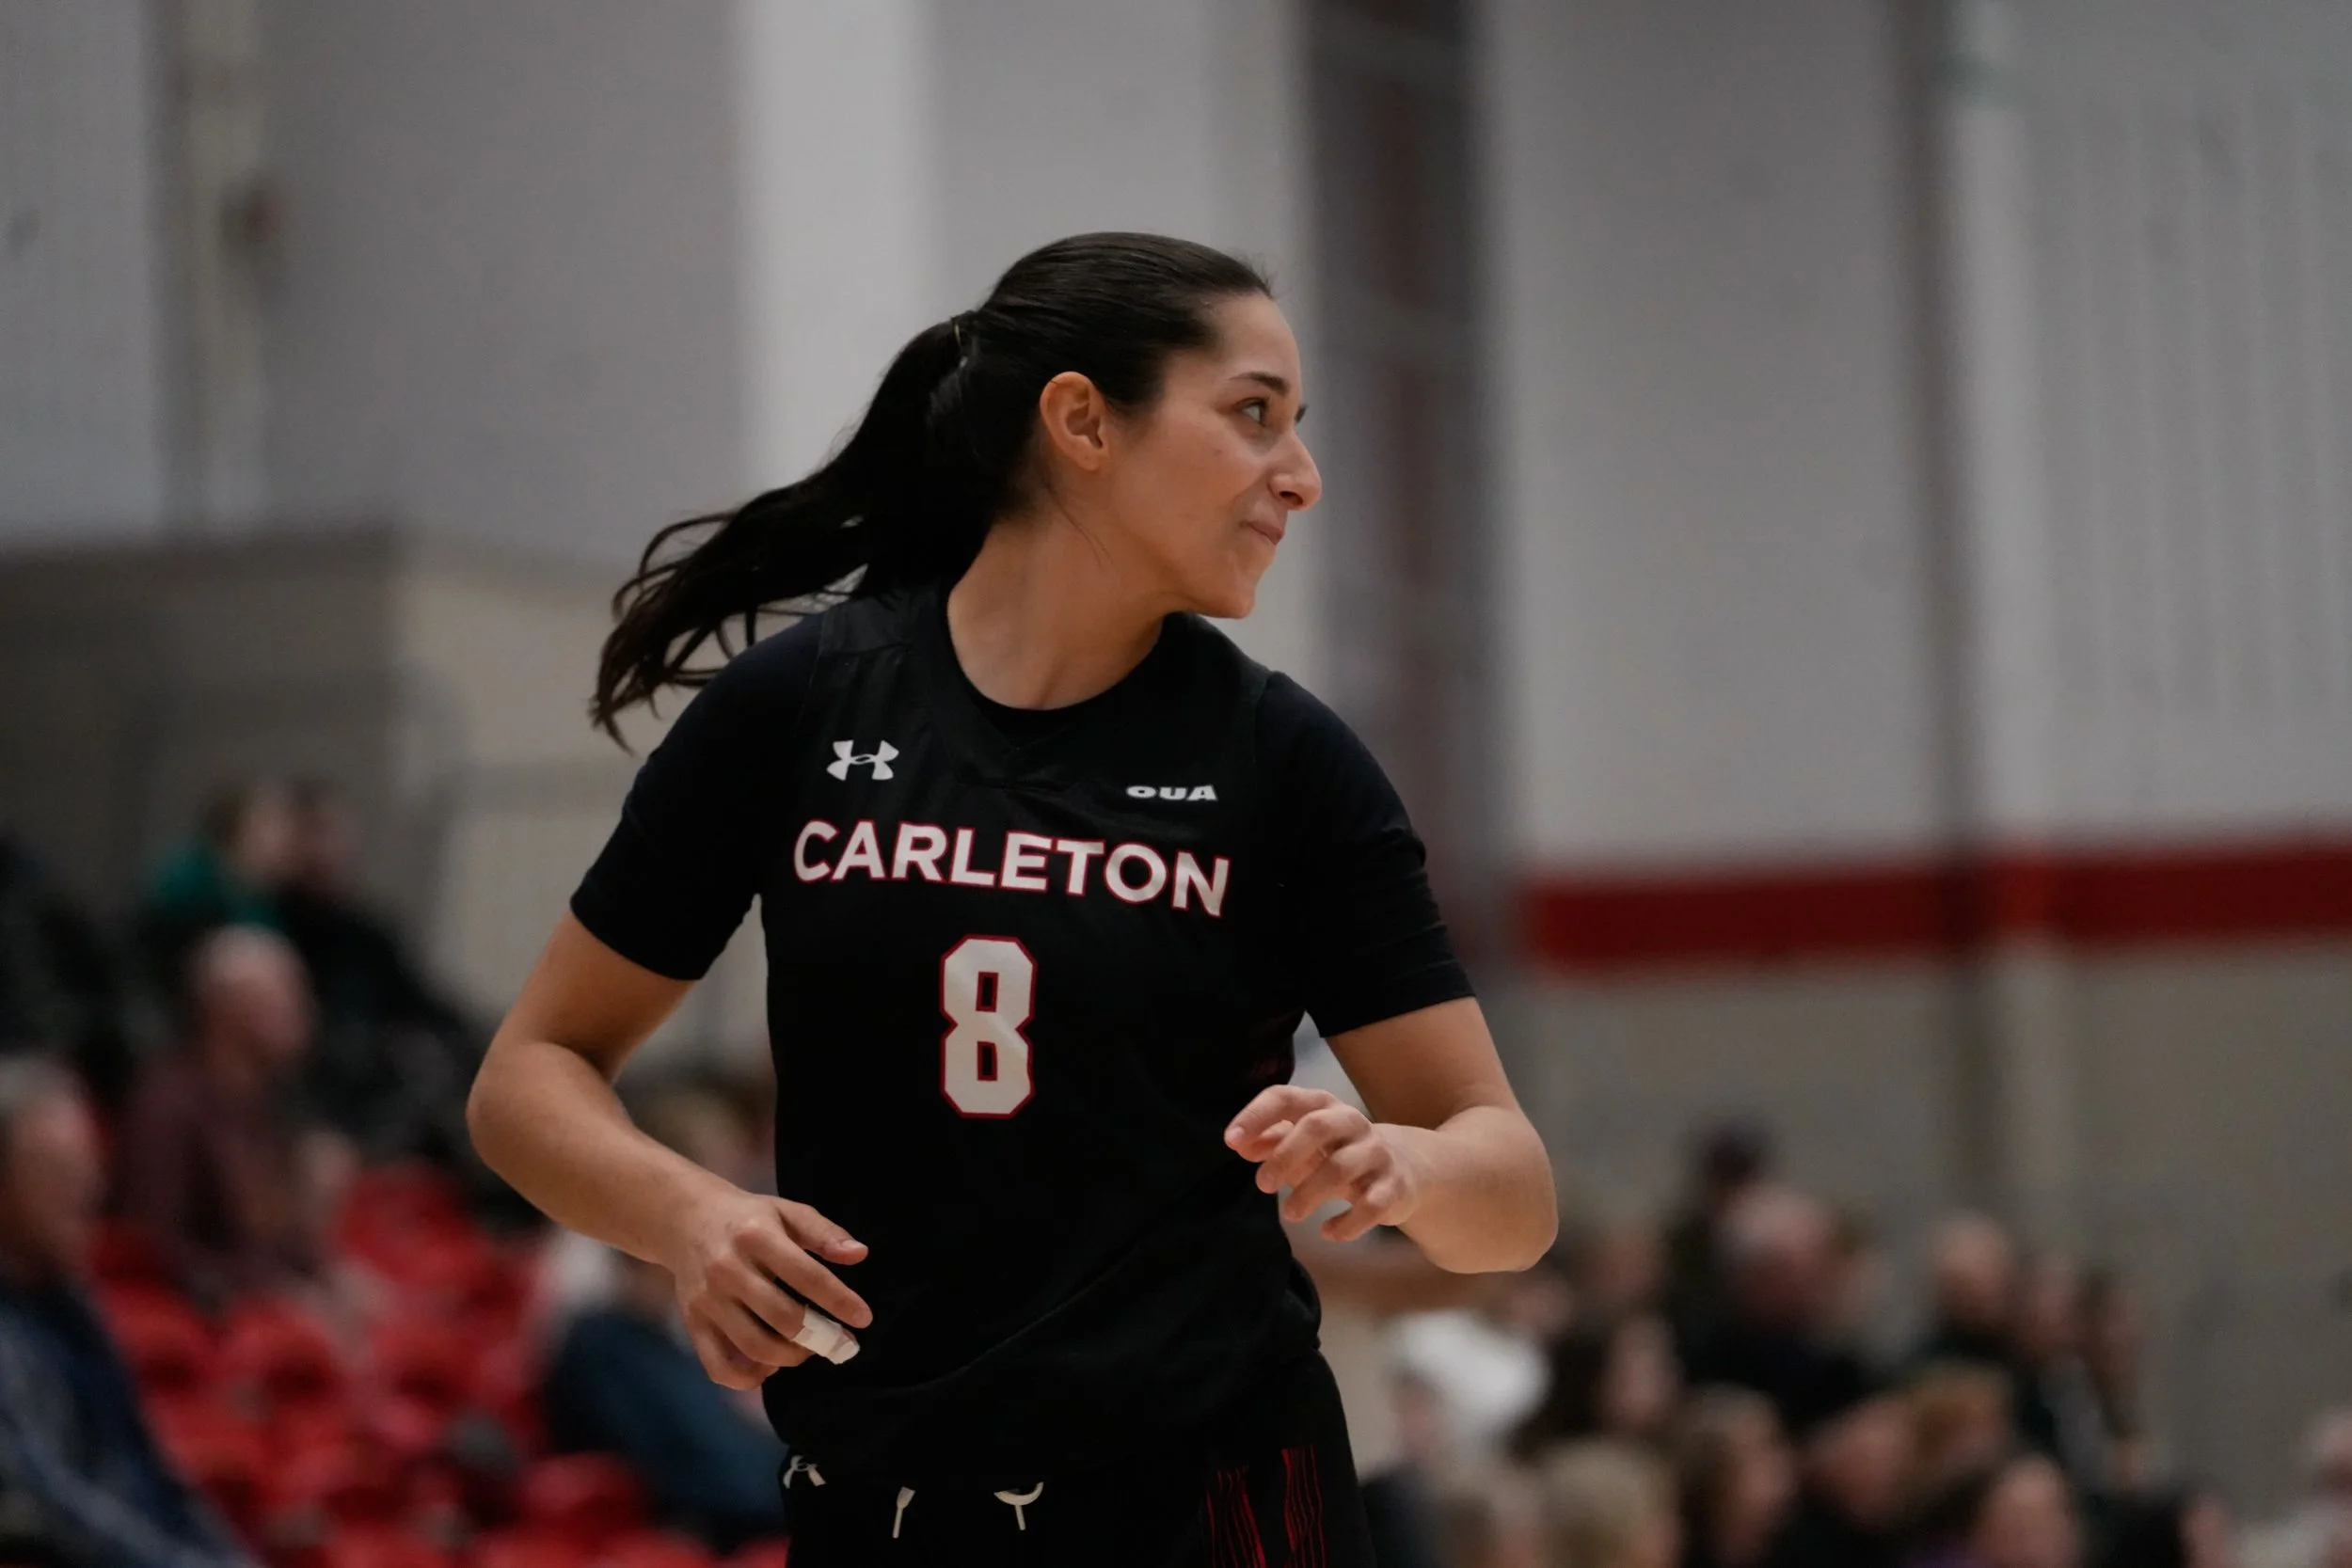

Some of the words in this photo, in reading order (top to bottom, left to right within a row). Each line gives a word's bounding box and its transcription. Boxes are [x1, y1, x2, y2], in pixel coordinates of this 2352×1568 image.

[1125, 784, 1218, 801] OUA
[793, 818, 1232, 918] CARLETON
[939, 933, 1039, 1119] 8
